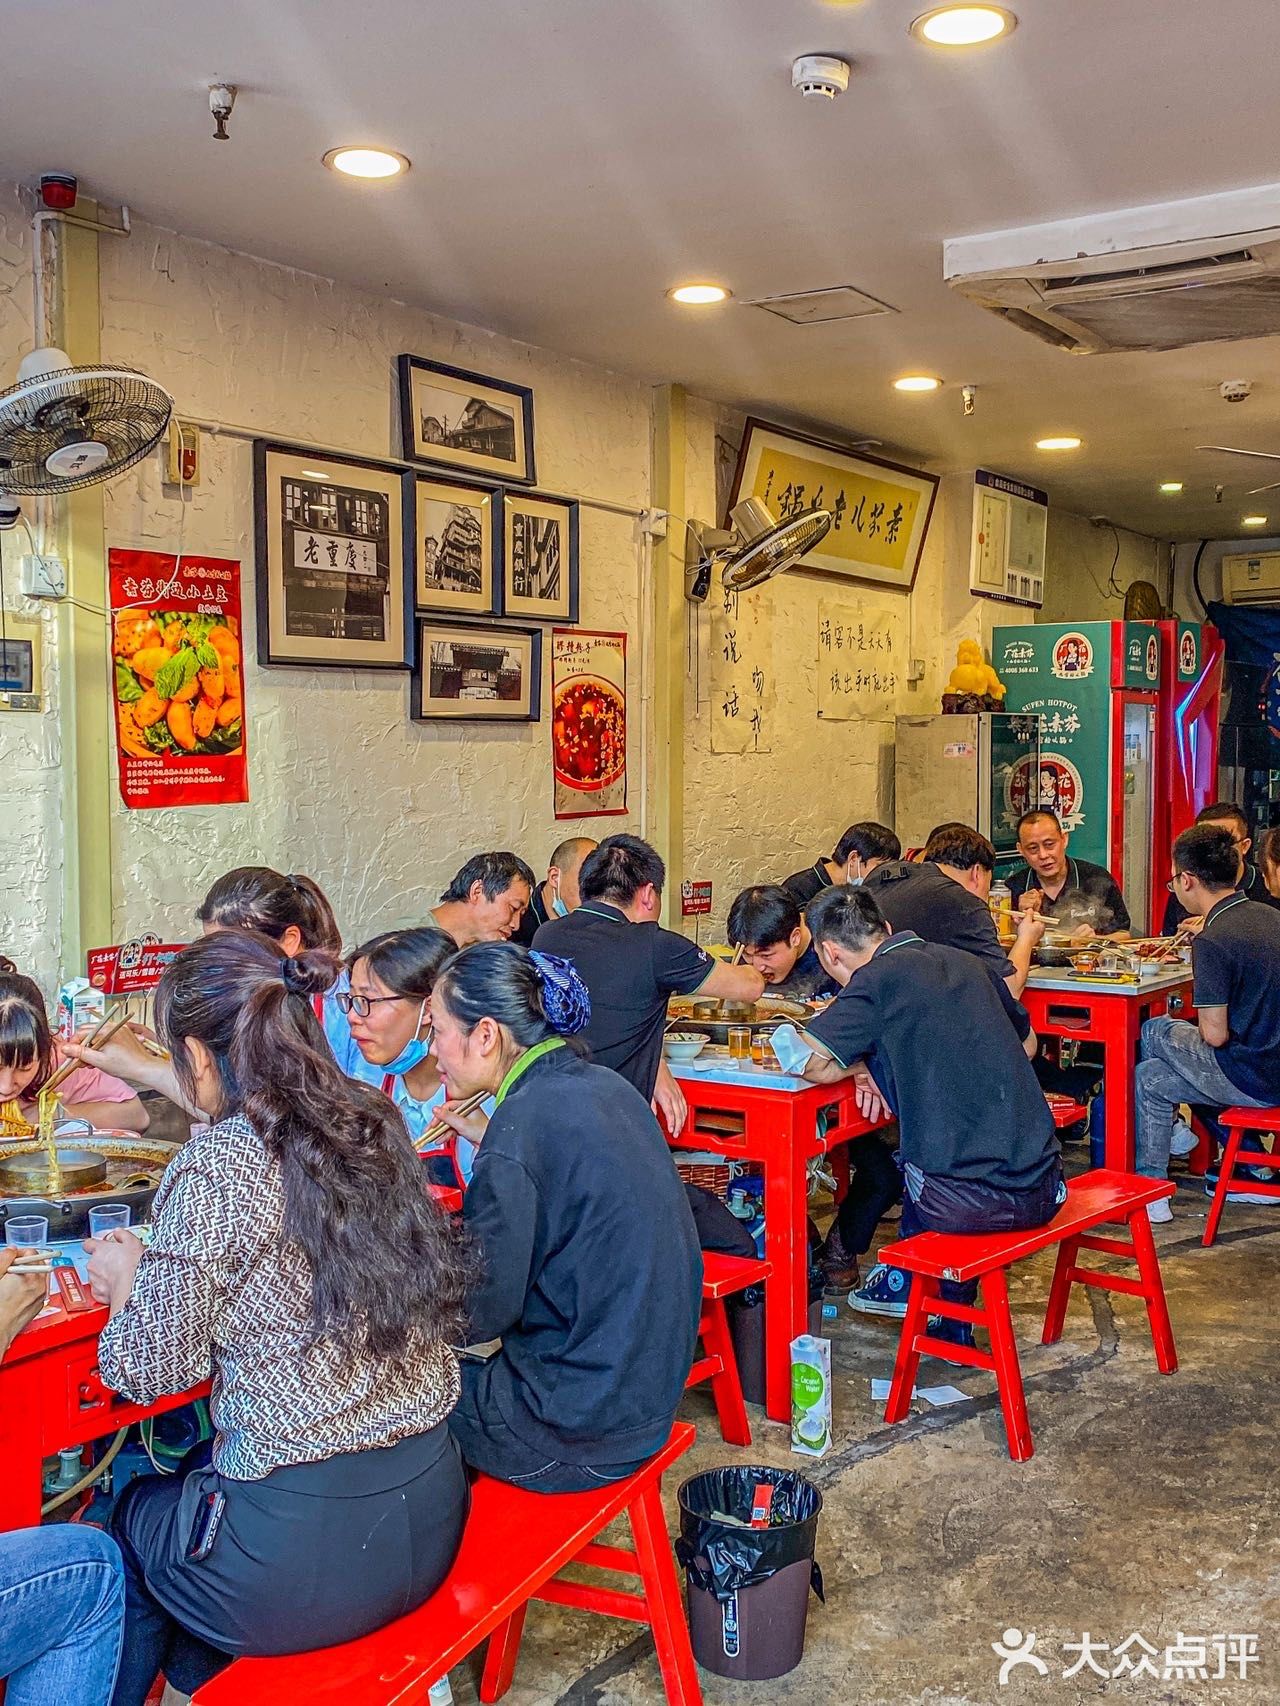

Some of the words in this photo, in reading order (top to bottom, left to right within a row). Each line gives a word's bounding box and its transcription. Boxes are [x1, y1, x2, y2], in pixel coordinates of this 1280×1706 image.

[1021, 699, 1045, 712] SUFEN
[1047, 699, 1078, 712] HOTPOT
[800, 1375, 820, 1386] Coconut
[805, 1385, 820, 1393] Water
